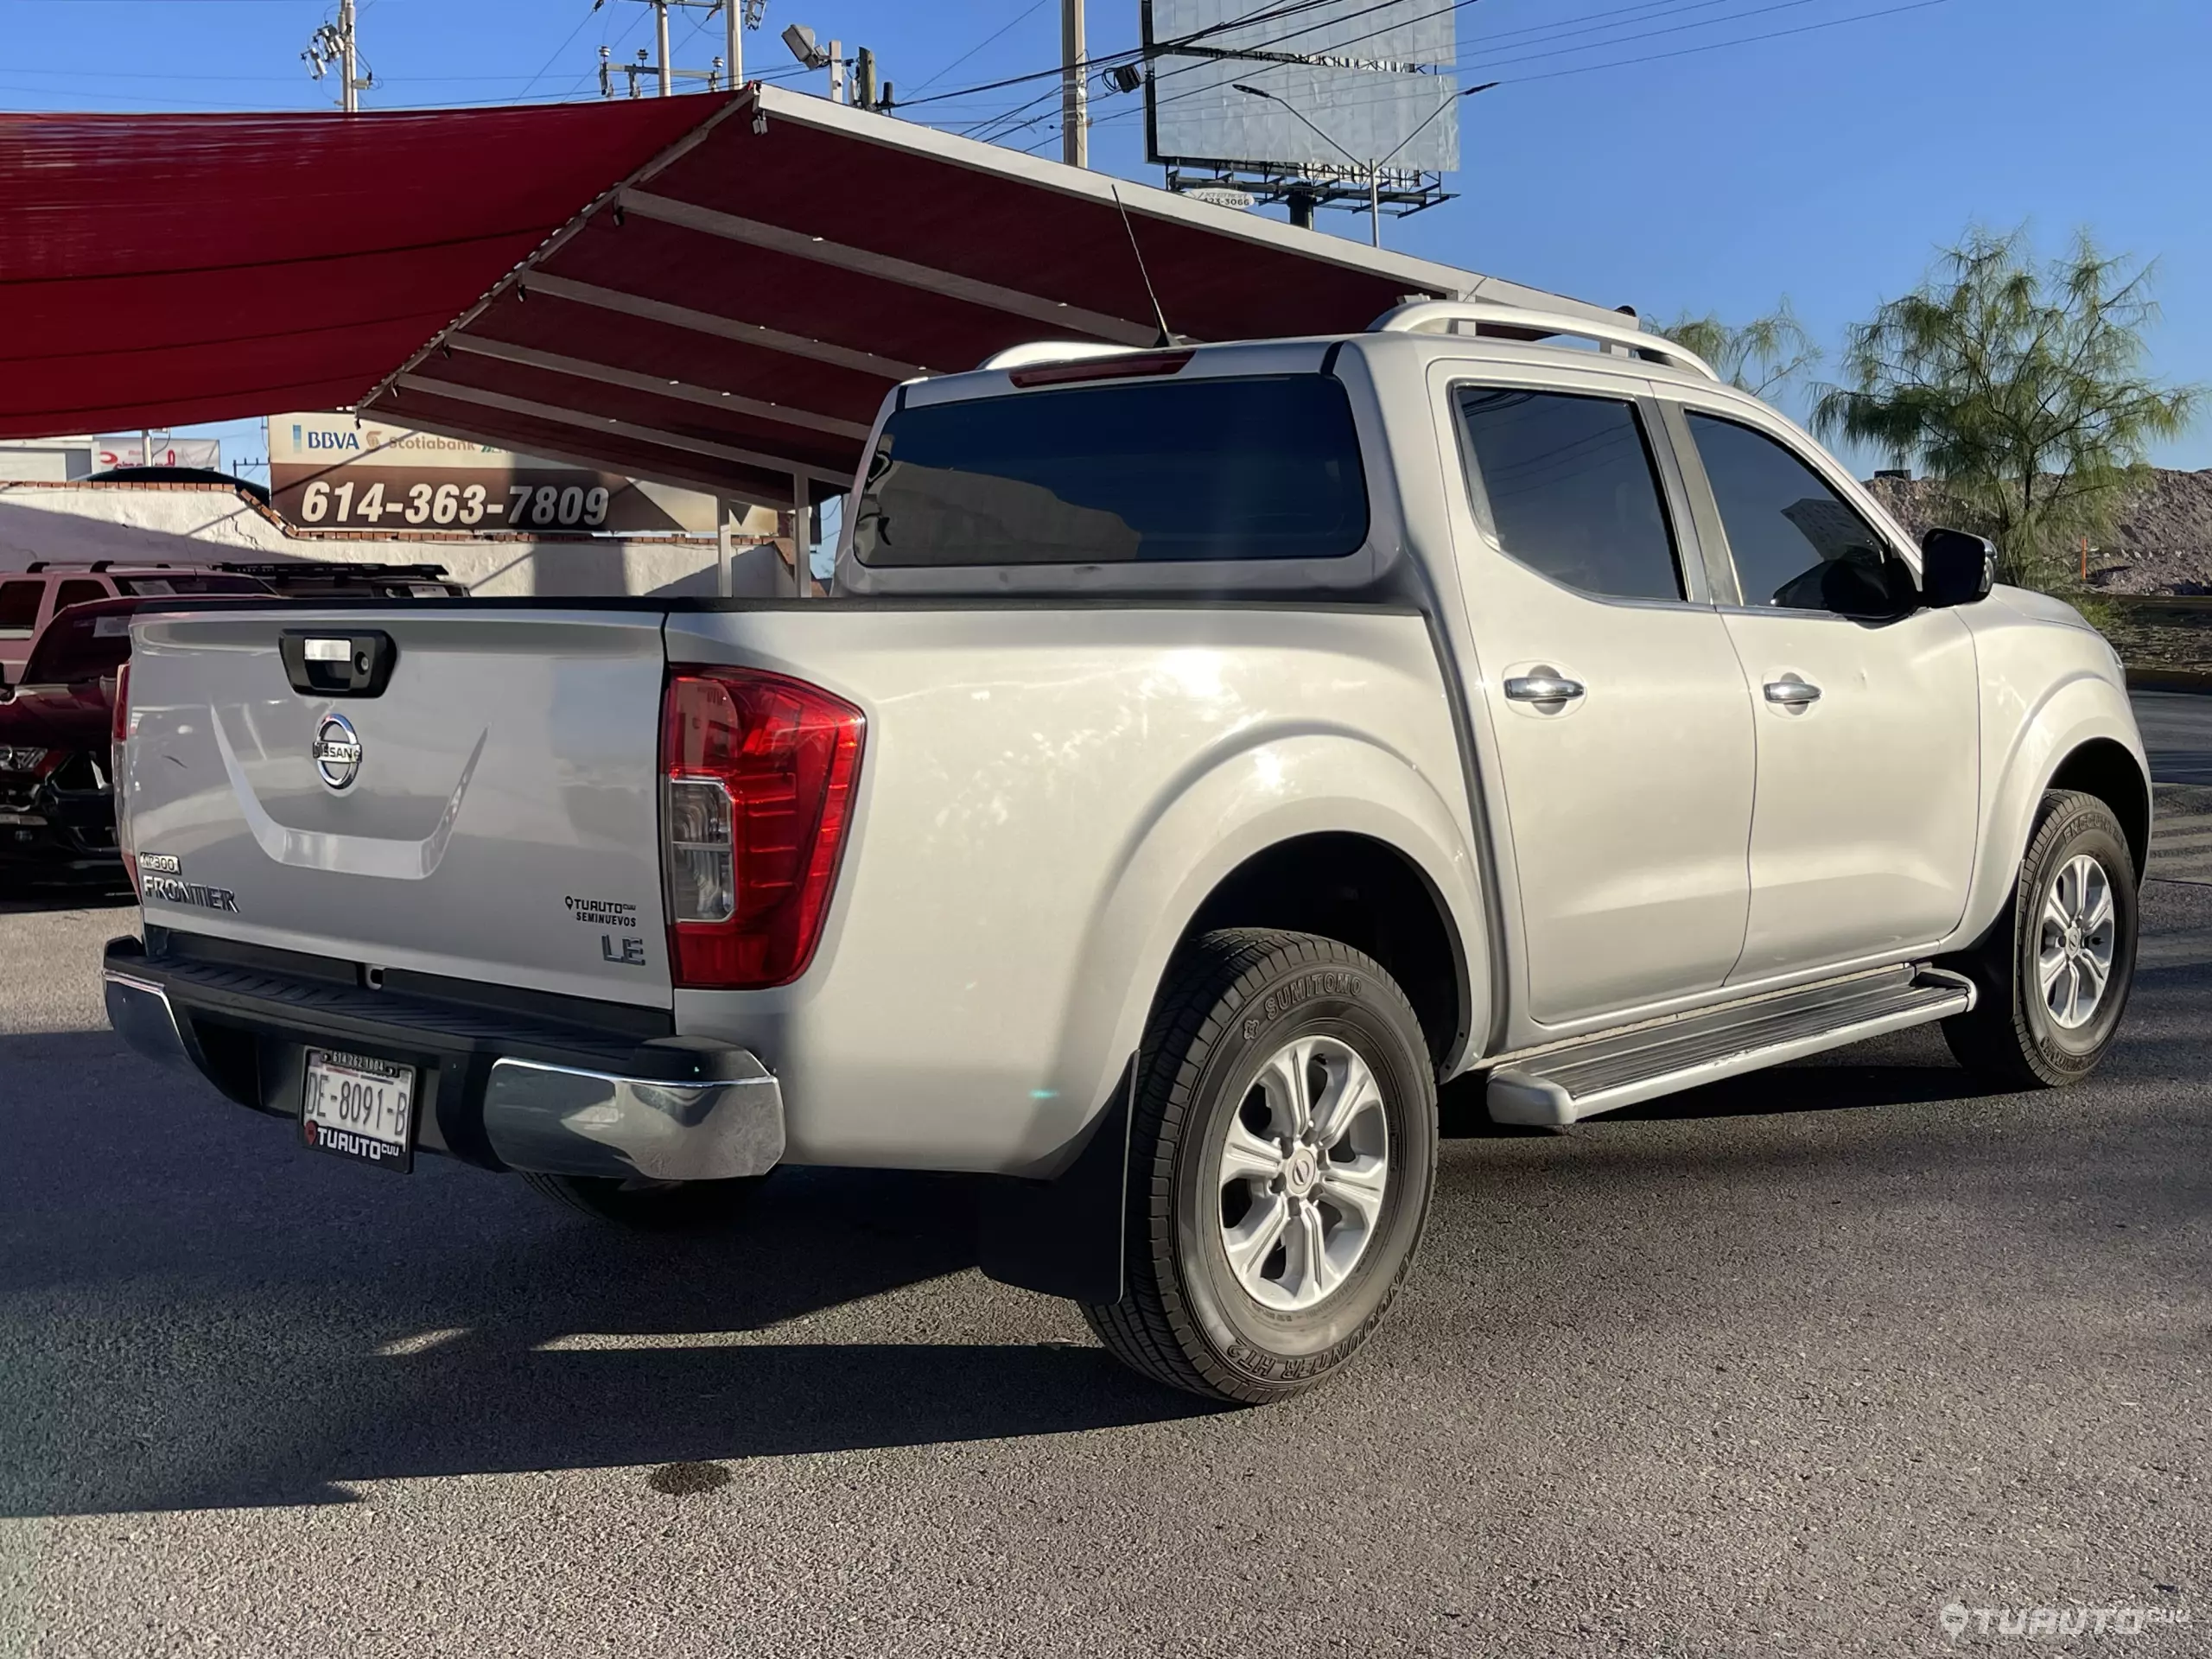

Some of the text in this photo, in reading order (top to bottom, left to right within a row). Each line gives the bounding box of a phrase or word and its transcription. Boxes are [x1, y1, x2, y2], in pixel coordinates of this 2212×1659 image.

[308, 431, 359, 450] BBVA
[389, 435, 475, 451] Scotiabank
[302, 480, 610, 525] 614-363-7809
[314, 742, 354, 760] ISSAN
[142, 853, 176, 872] NP300
[143, 875, 240, 913] FRONTIER
[576, 912, 637, 927] SEMINUEVOS
[601, 934, 646, 966] LE
[1264, 972, 1362, 1021] SUMITOMO
[333, 1051, 347, 1064] 614
[305, 1071, 408, 1136] DE-8091-B
[1226, 1337, 1277, 1377] HT2
